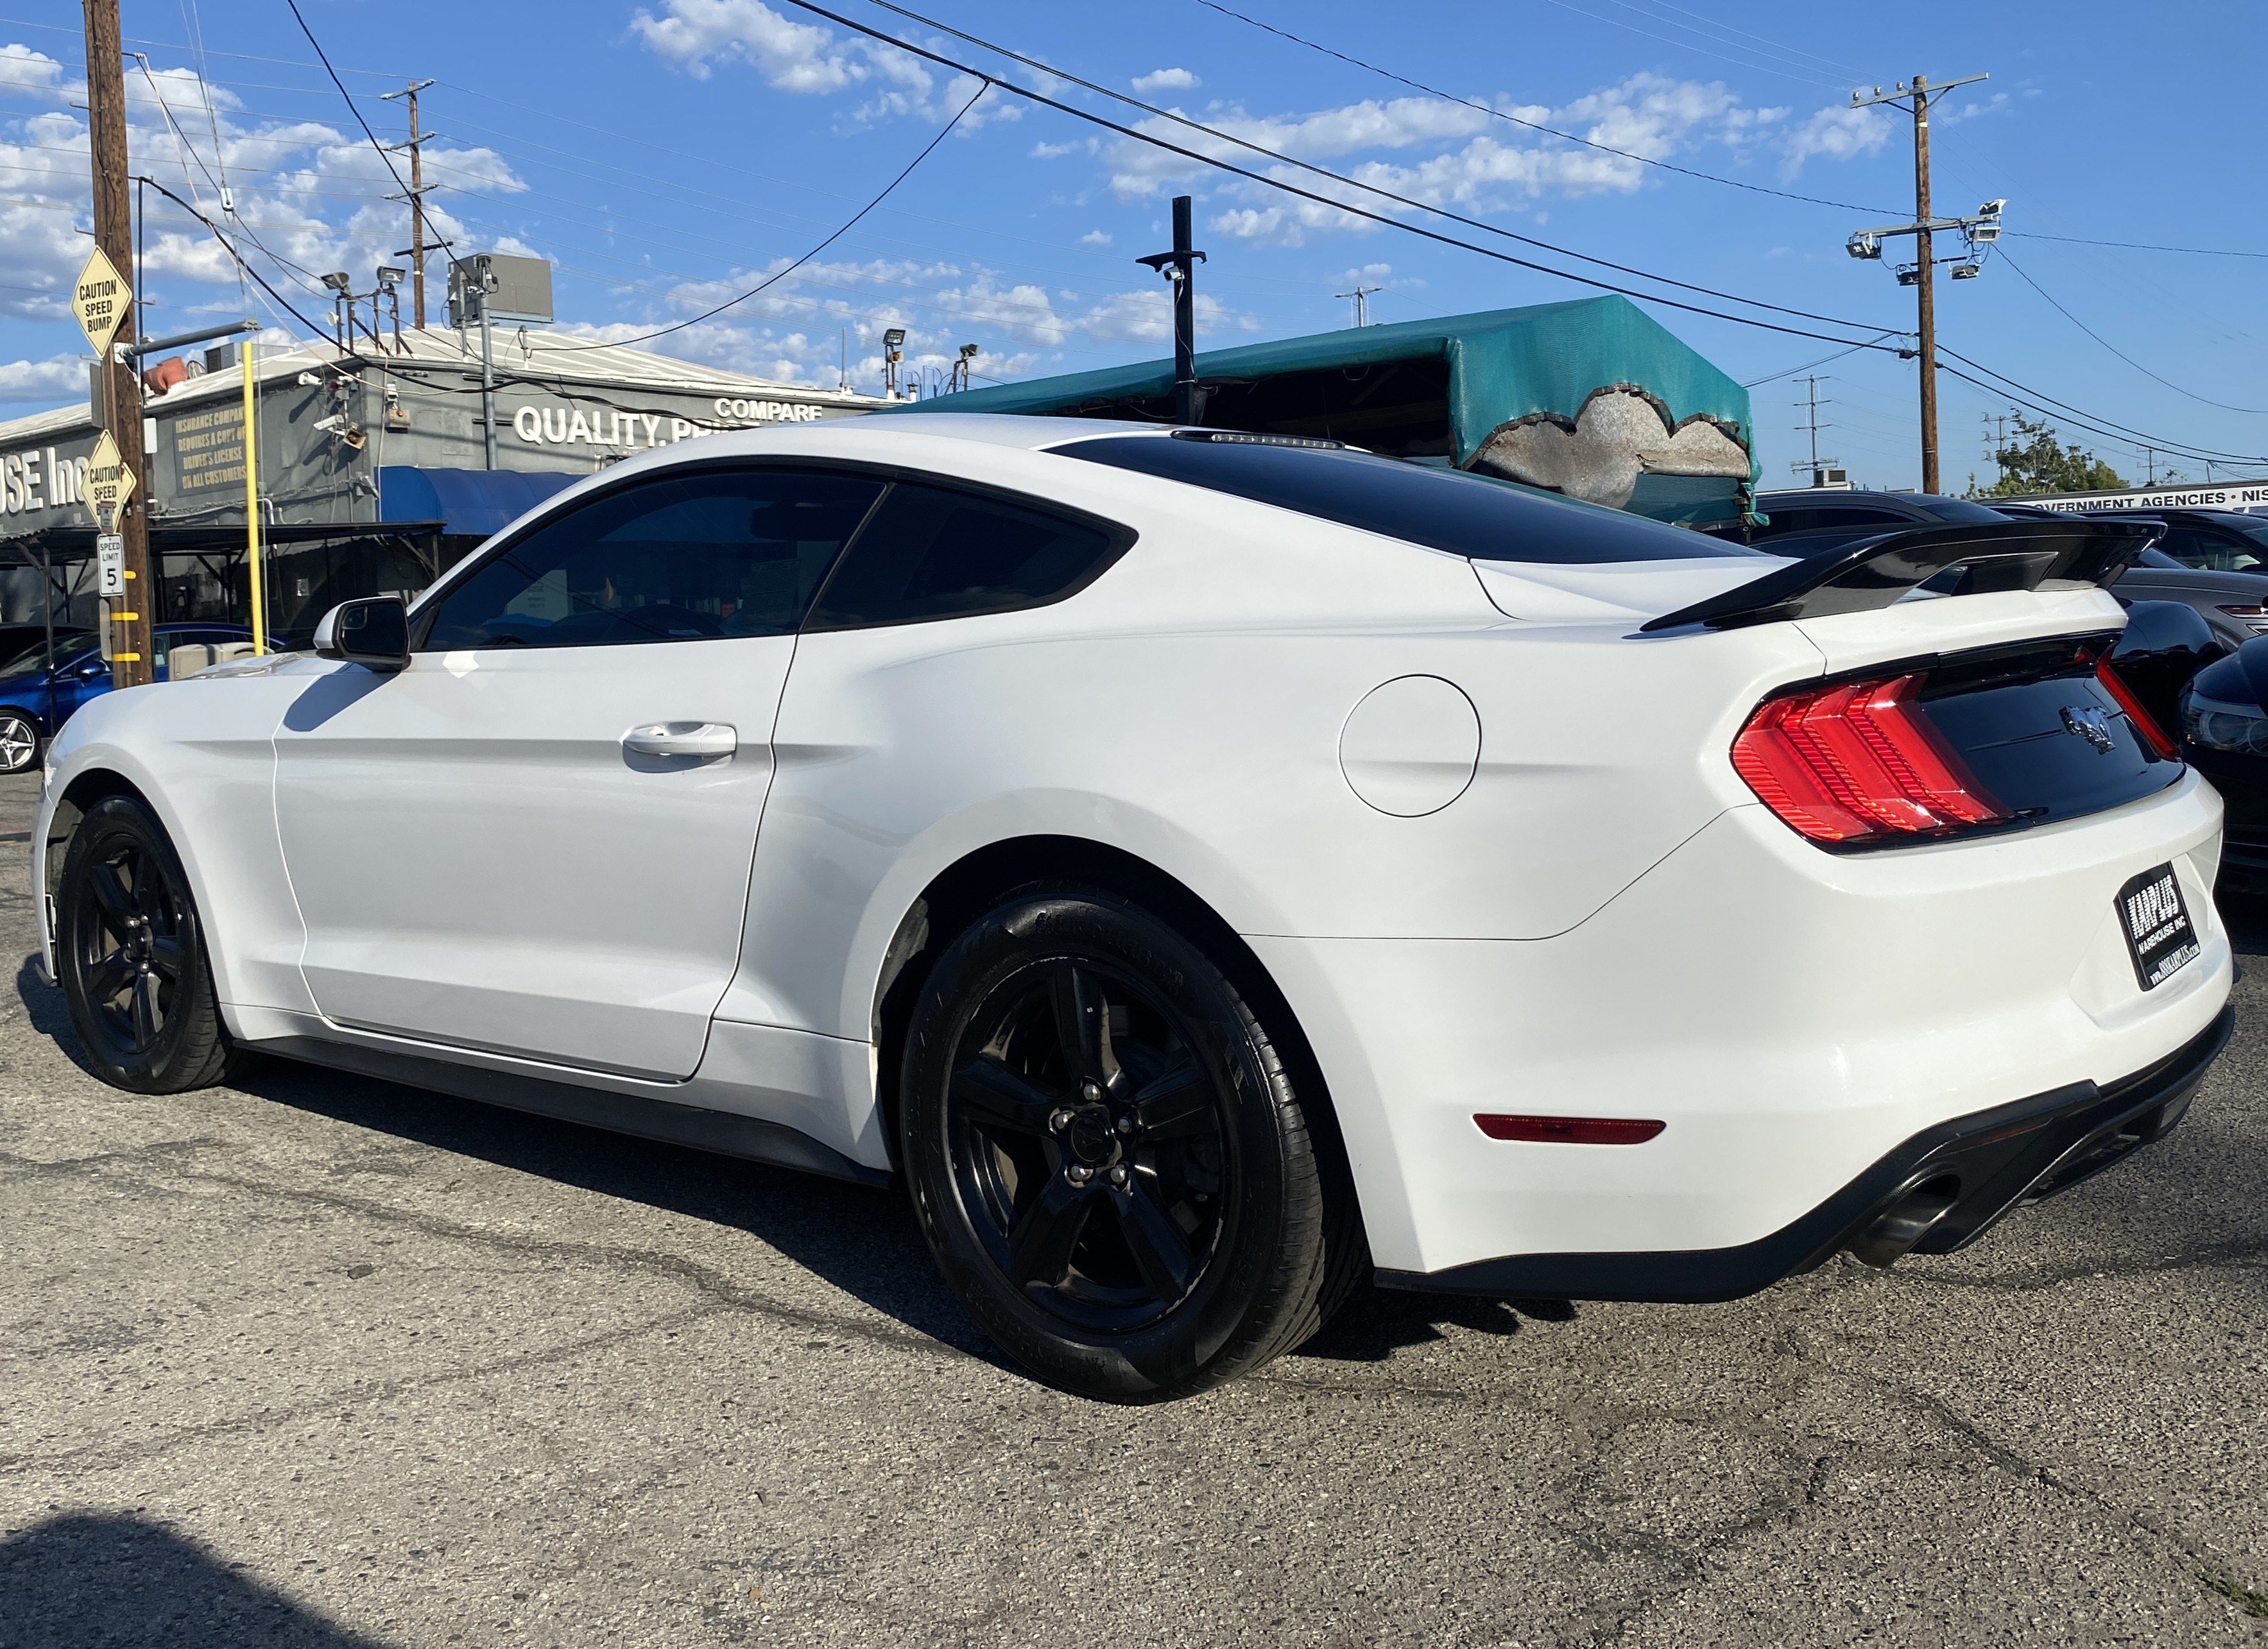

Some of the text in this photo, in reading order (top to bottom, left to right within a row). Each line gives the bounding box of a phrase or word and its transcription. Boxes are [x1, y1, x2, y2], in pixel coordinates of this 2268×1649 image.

[79, 279, 117, 301] CAUTION
[85, 300, 112, 317] SPEED
[87, 316, 112, 332] BUMP
[714, 398, 823, 422] COMPARE
[176, 413, 213, 433] INSURANCE
[178, 433, 210, 452] REQUIRES
[210, 432, 216, 445] A
[217, 427, 236, 444] COPY
[183, 446, 243, 470] DRIVER'S LICENSE
[0, 450, 44, 513] SE
[89, 465, 121, 484] CAUTION
[182, 465, 246, 489] ON ALL CUSTOMERS
[94, 485, 117, 500] SPEED
[2142, 492, 2226, 507] AGENCIES
[96, 501, 117, 516] BP
[100, 542, 121, 551] SPEED
[102, 552, 119, 561] LIMIT
[107, 568, 117, 586] 5
[2138, 915, 2186, 955] WAREHOUSE INC
